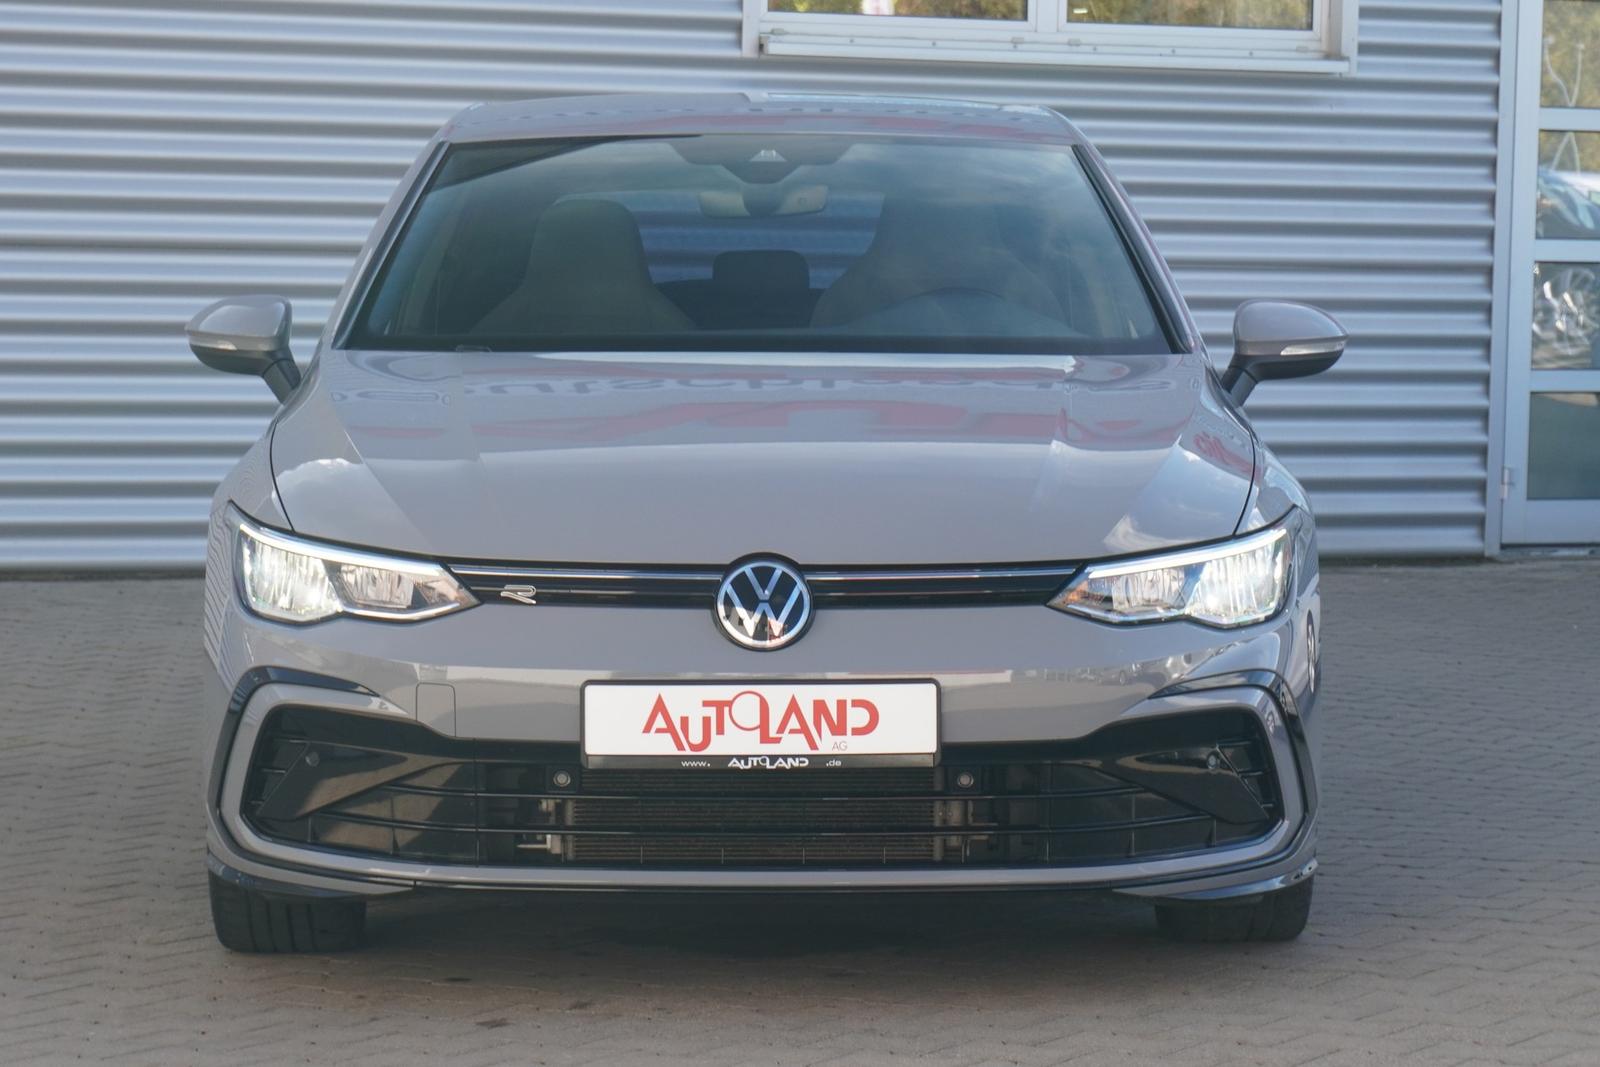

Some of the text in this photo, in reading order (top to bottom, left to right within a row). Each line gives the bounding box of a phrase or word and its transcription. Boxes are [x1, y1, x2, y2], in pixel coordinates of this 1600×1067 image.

[642, 690, 880, 752] AUTOLAND
[832, 741, 848, 751] AG
[681, 759, 711, 767] www.
[826, 758, 842, 767] .de
